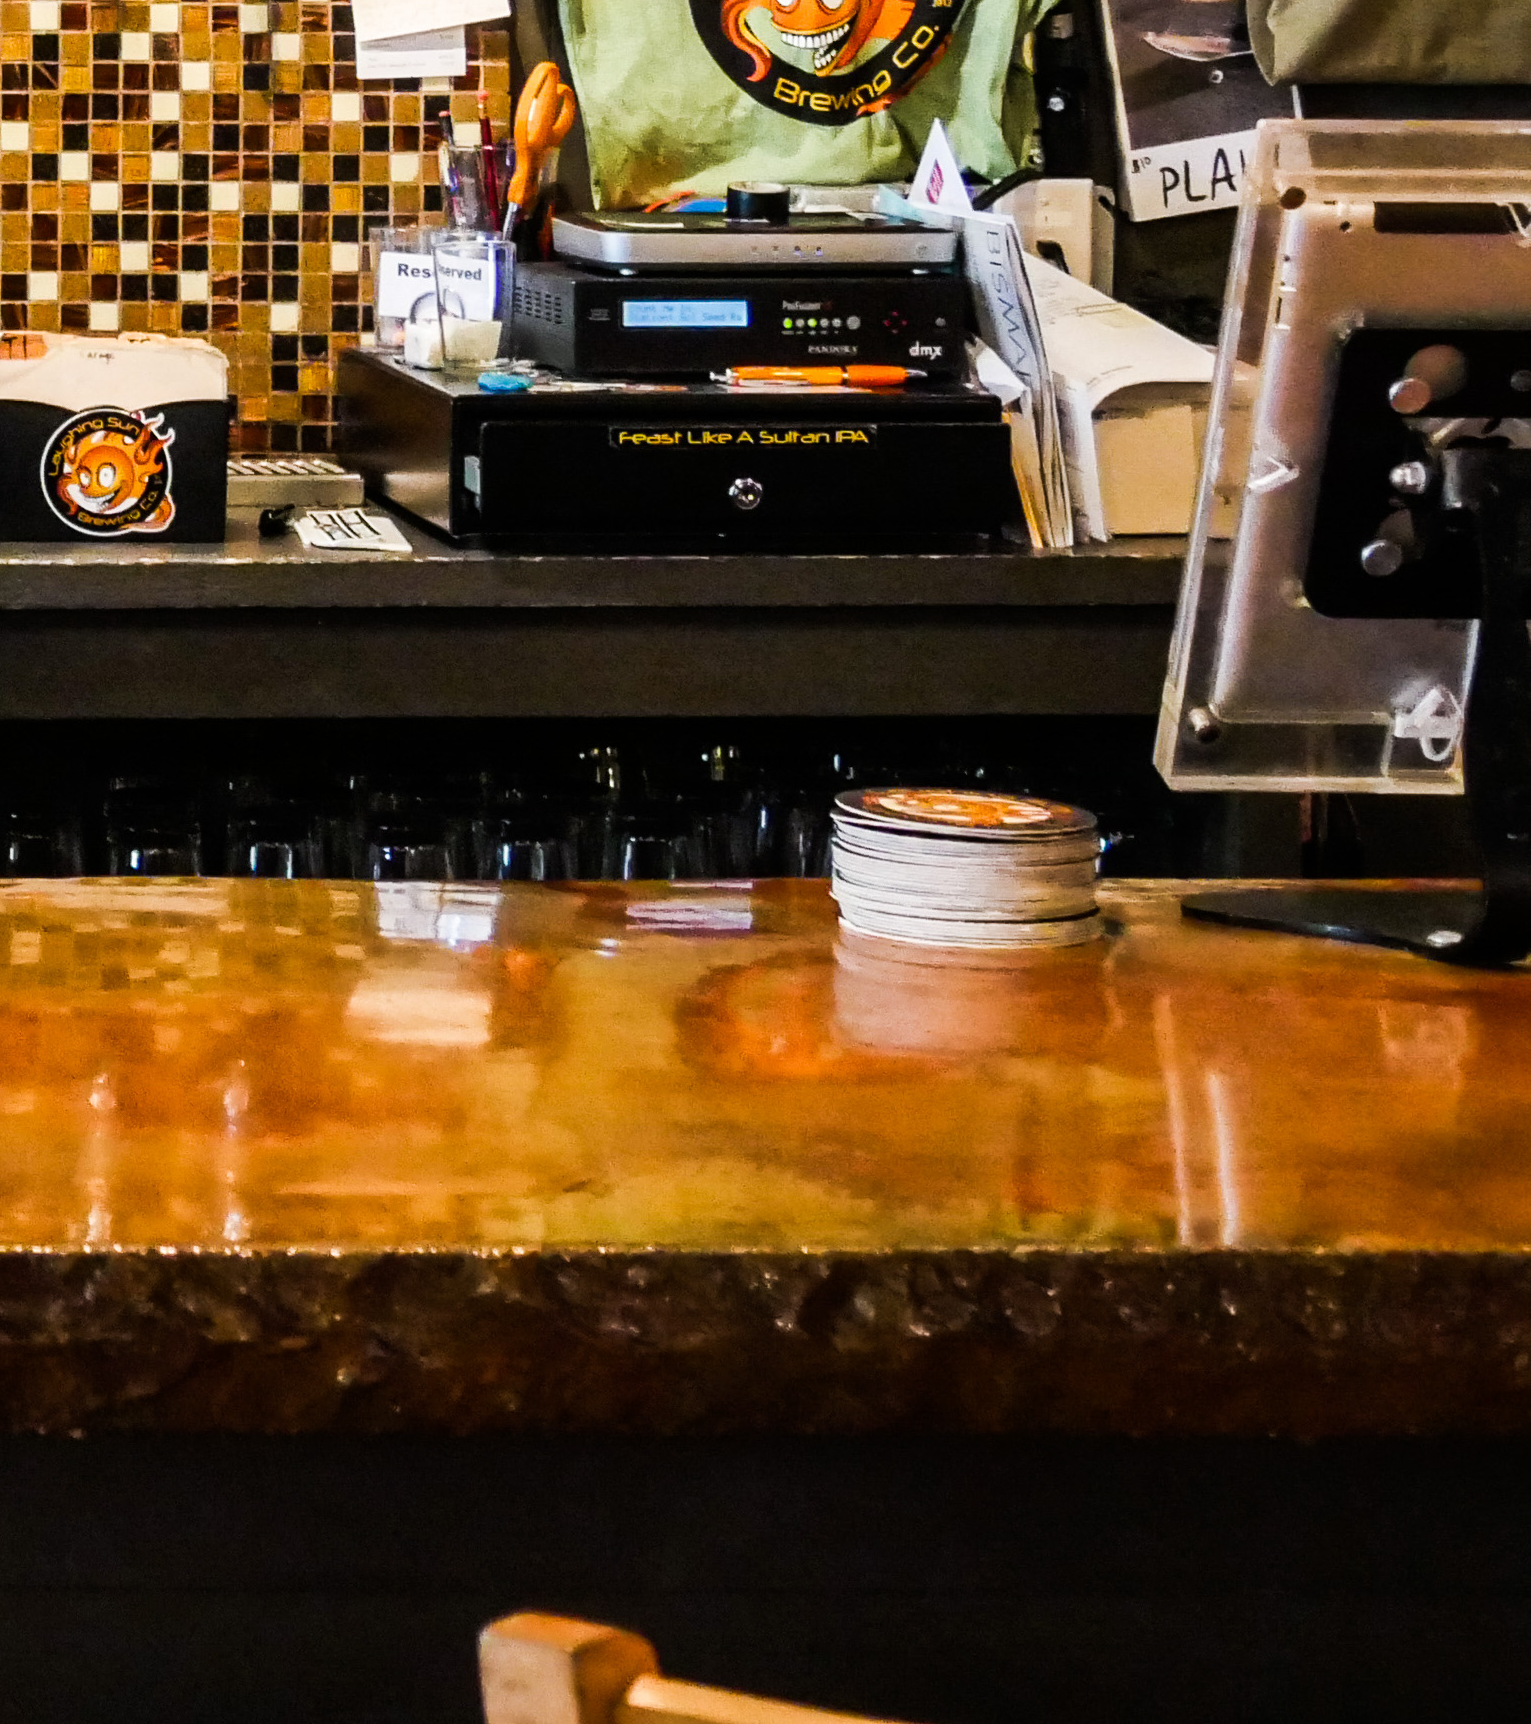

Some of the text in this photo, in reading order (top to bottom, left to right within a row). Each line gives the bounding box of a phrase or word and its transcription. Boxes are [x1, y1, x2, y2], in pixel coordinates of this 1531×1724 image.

[774, 25, 939, 112] Brewing Co.
[909, 342, 942, 360] dmx
[619, 431, 868, 445] Feast Like A Sultan IPA
